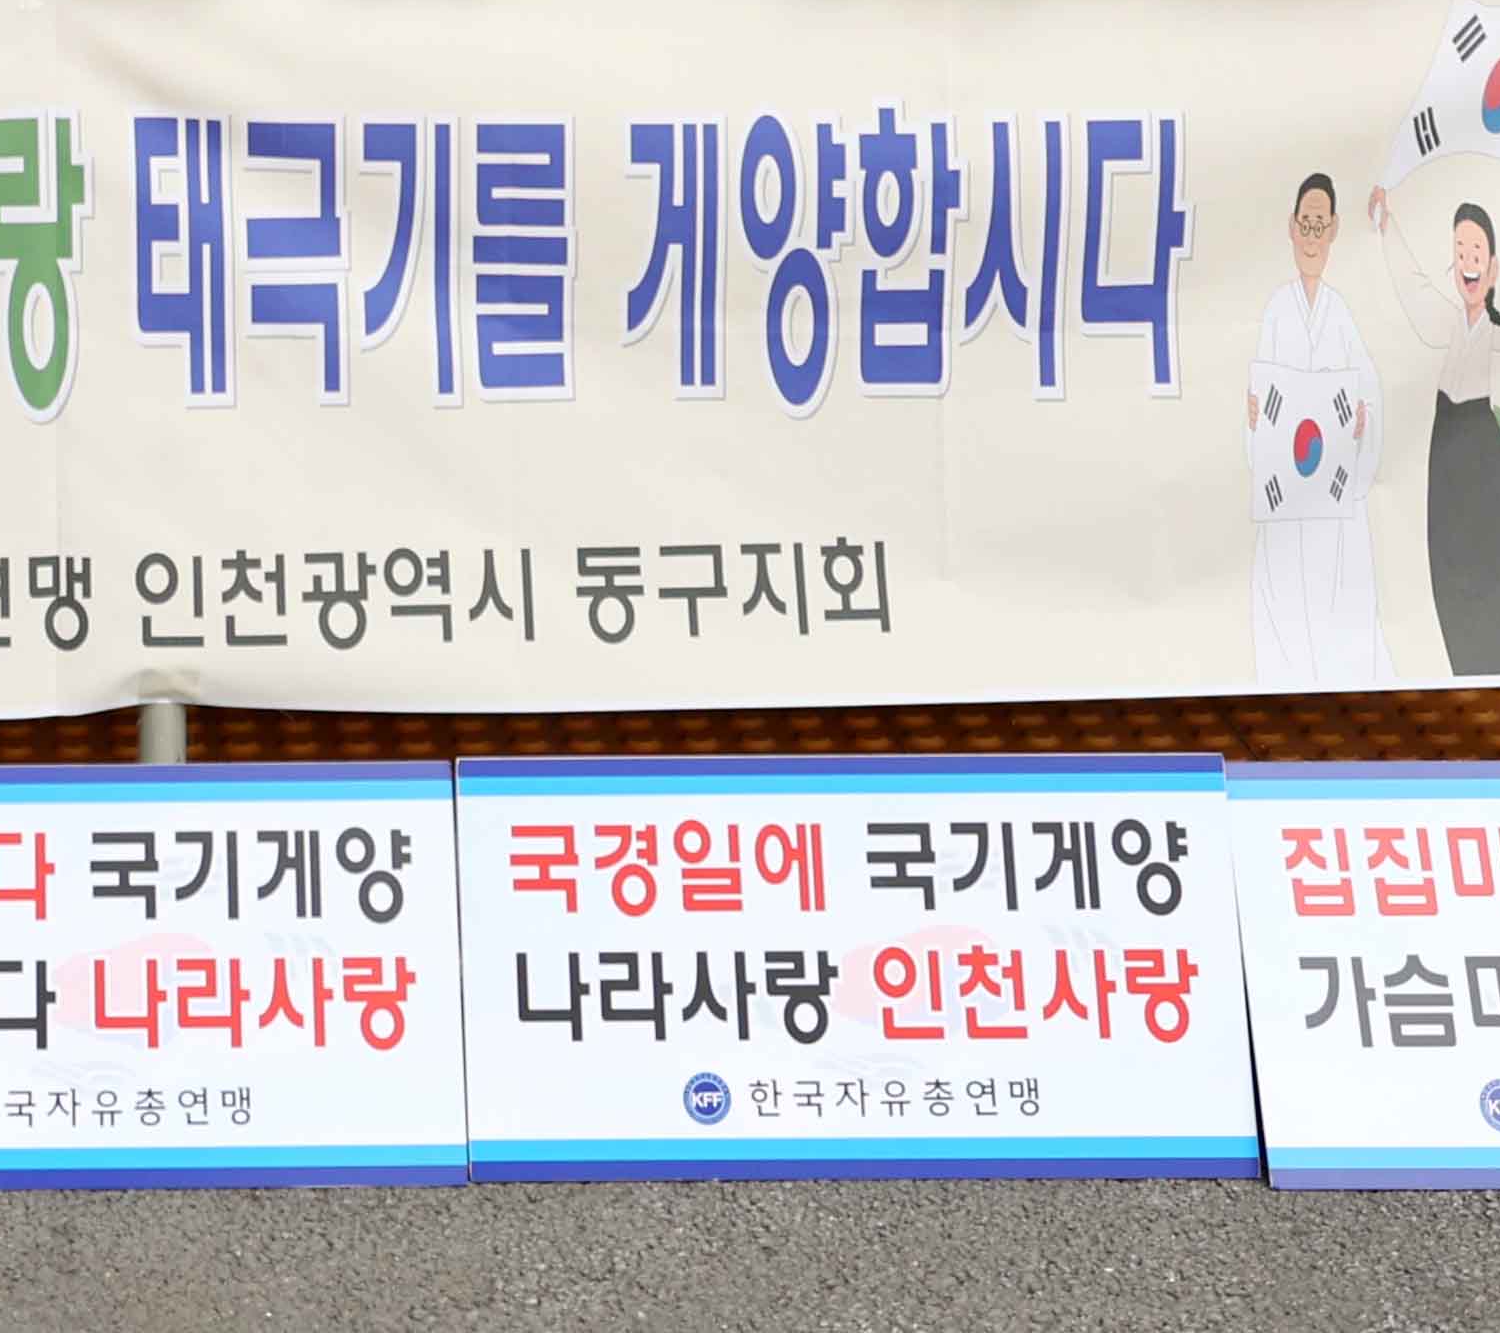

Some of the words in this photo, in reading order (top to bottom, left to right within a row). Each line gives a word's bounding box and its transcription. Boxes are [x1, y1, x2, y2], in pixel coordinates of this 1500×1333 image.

[134, 116, 571, 397] 태극기를
[624, 106, 1189, 408] 게양합시다
[135, 547, 536, 651] 인천광역시
[575, 537, 894, 645] 동구지회
[89, 826, 412, 924] 국기게양
[509, 819, 827, 917] 국경일에
[866, 818, 1189, 916] 국기게양
[93, 956, 416, 1051] 나라사랑
[516, 949, 839, 1045] 나라사랑
[873, 946, 1199, 1043] 인천사랑
[748, 1076, 1041, 1118] 한국자유총연맹
